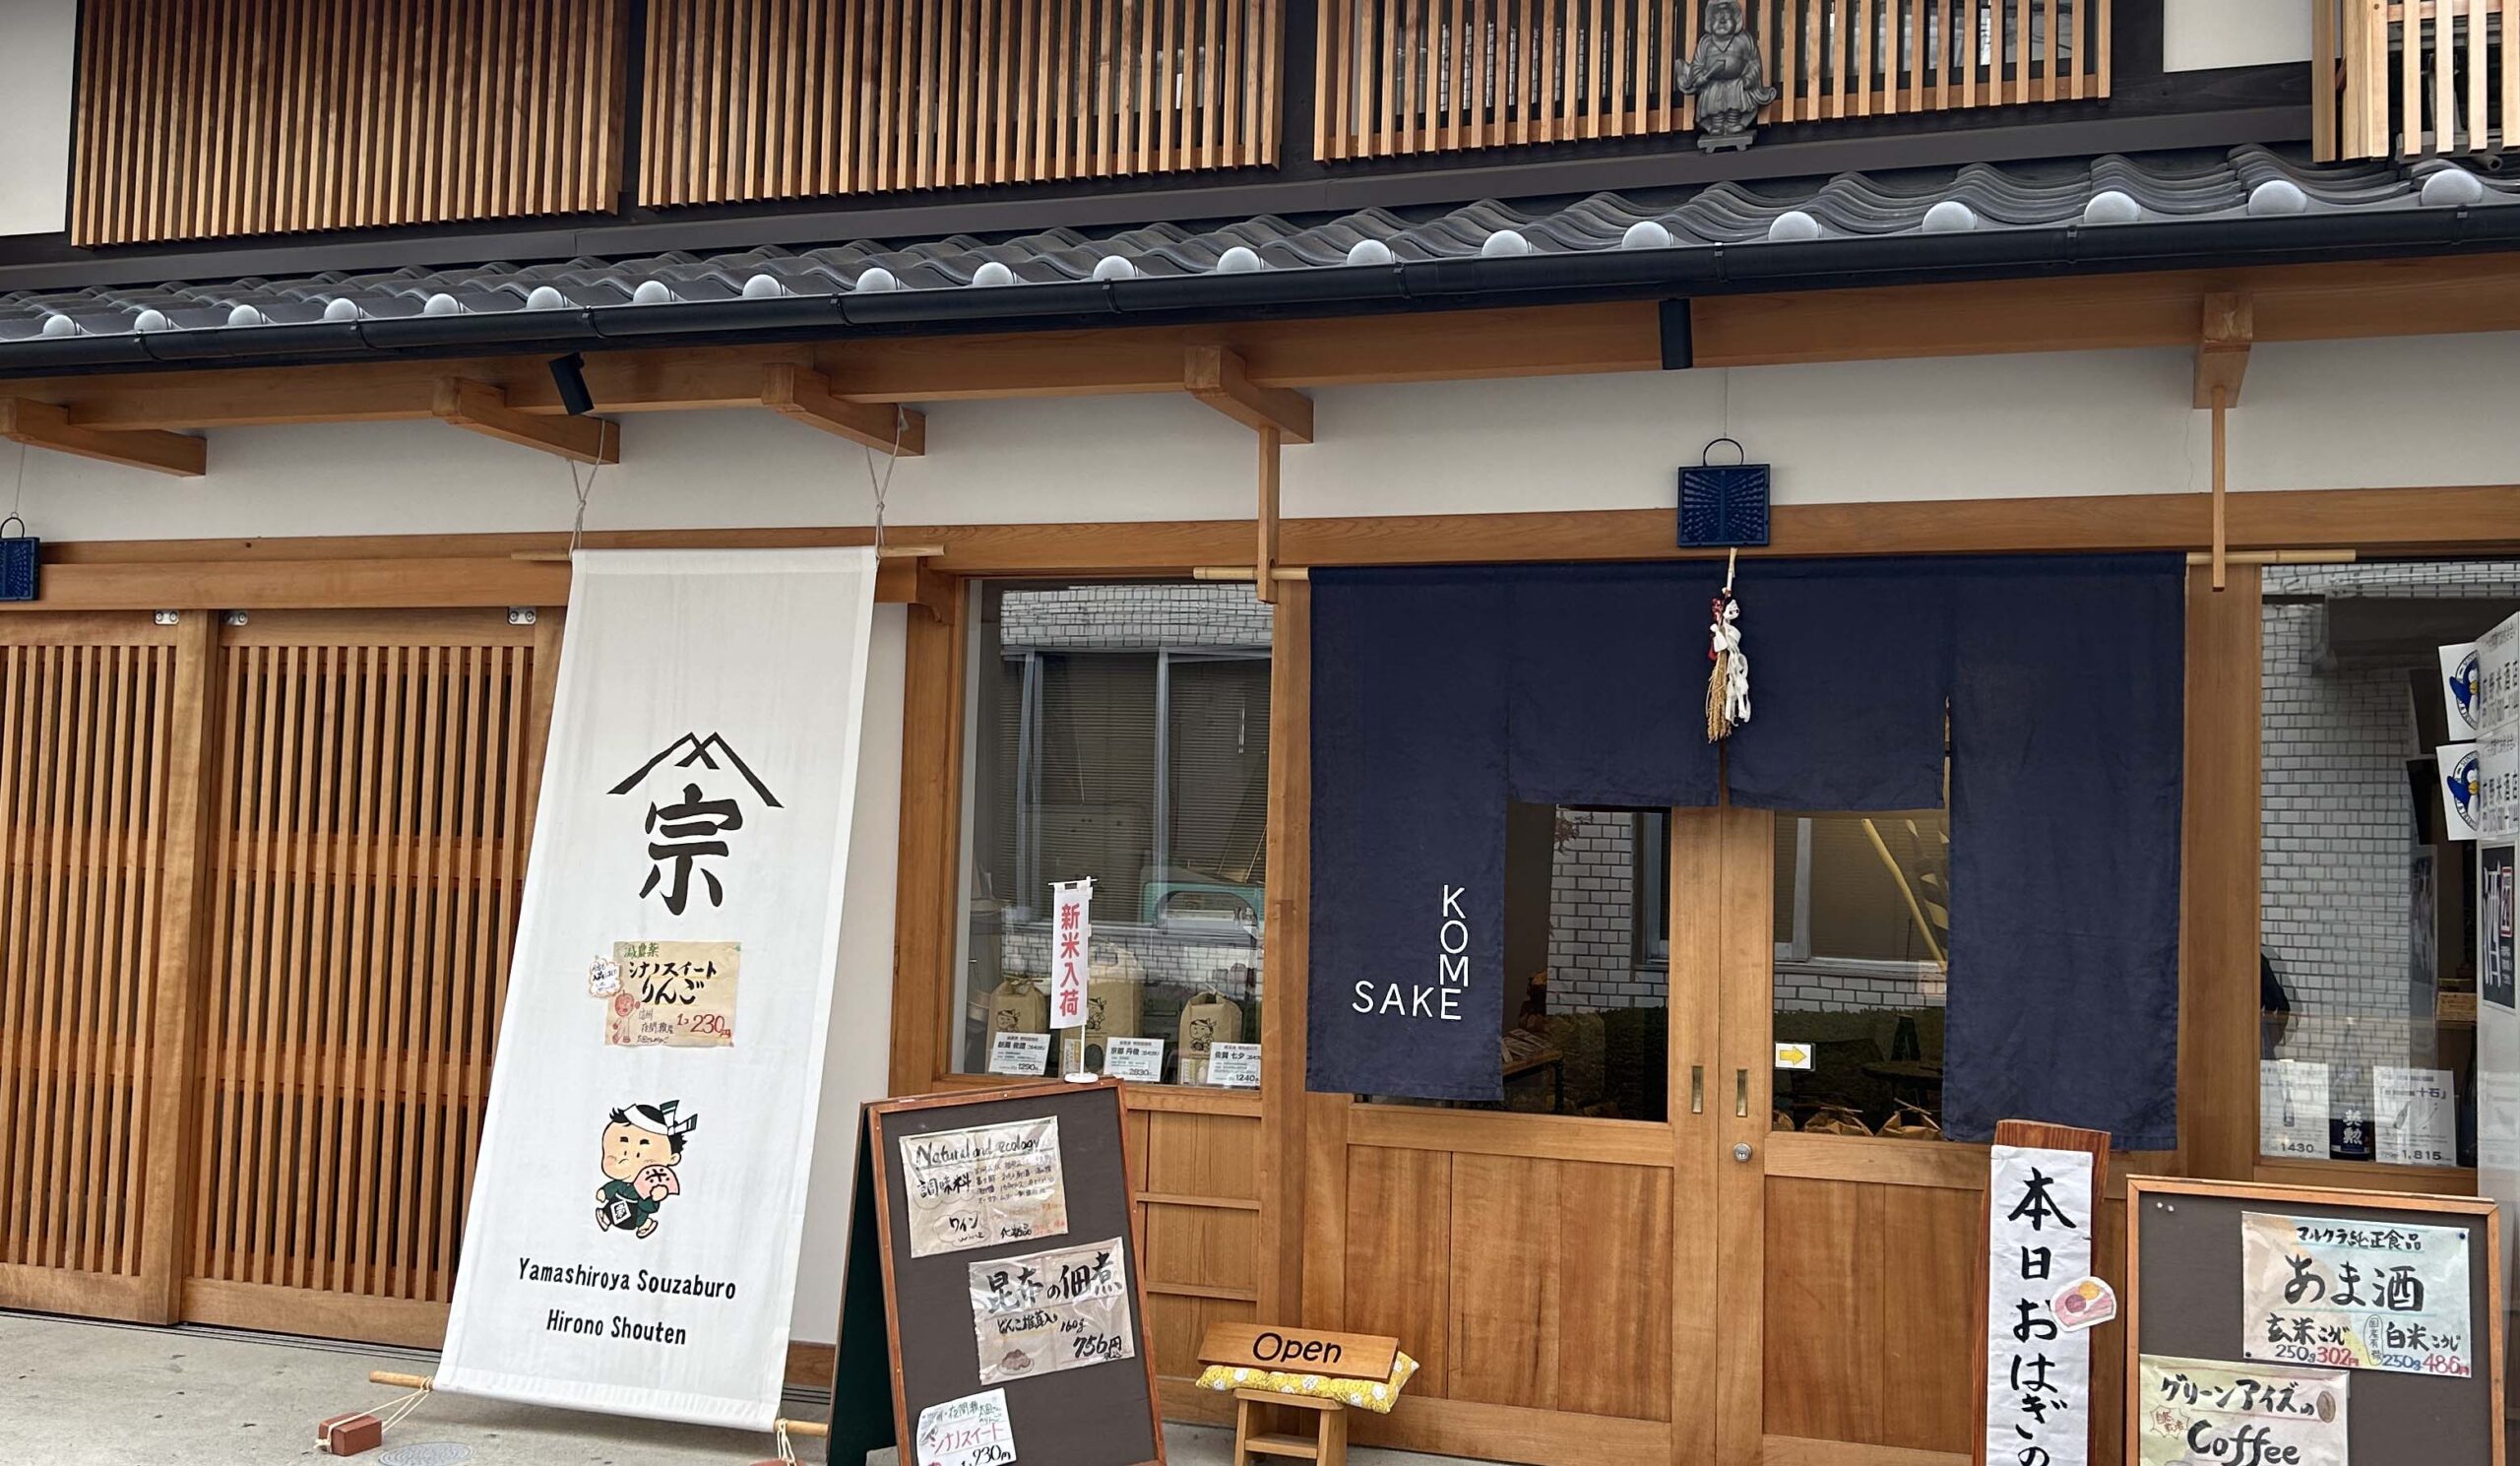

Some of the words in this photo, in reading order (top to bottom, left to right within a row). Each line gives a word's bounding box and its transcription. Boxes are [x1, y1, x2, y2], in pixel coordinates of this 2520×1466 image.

[639, 783, 744, 916] 宗
[628, 960, 718, 980] シナノスイート
[1059, 903, 1081, 1018] 新米入荷
[1438, 884, 1470, 1021] KOME
[640, 977, 705, 1005] りんご
[1352, 980, 1463, 1021] SAKE
[916, 1171, 972, 1198] 調味料
[949, 1210, 978, 1232] ワイン
[2297, 1226, 2422, 1250] マルクラ純正食品
[518, 1256, 630, 1292] Yamashiroya
[637, 1268, 736, 1300] Souzaburo
[985, 1251, 1123, 1313] 昆布の佃煮
[2284, 1253, 2425, 1312] あま酒
[546, 1308, 603, 1336] Hirono
[610, 1315, 686, 1345] Shouten
[2266, 1312, 2351, 1346] 玄米こうじ
[2386, 1321, 2461, 1352] 白米こうじ
[1252, 1331, 1343, 1364] Open
[2161, 1373, 2315, 1417] グリーンアイズの
[929, 1422, 1004, 1454] シナノスイート
[2186, 1418, 2301, 1466] Coffee
